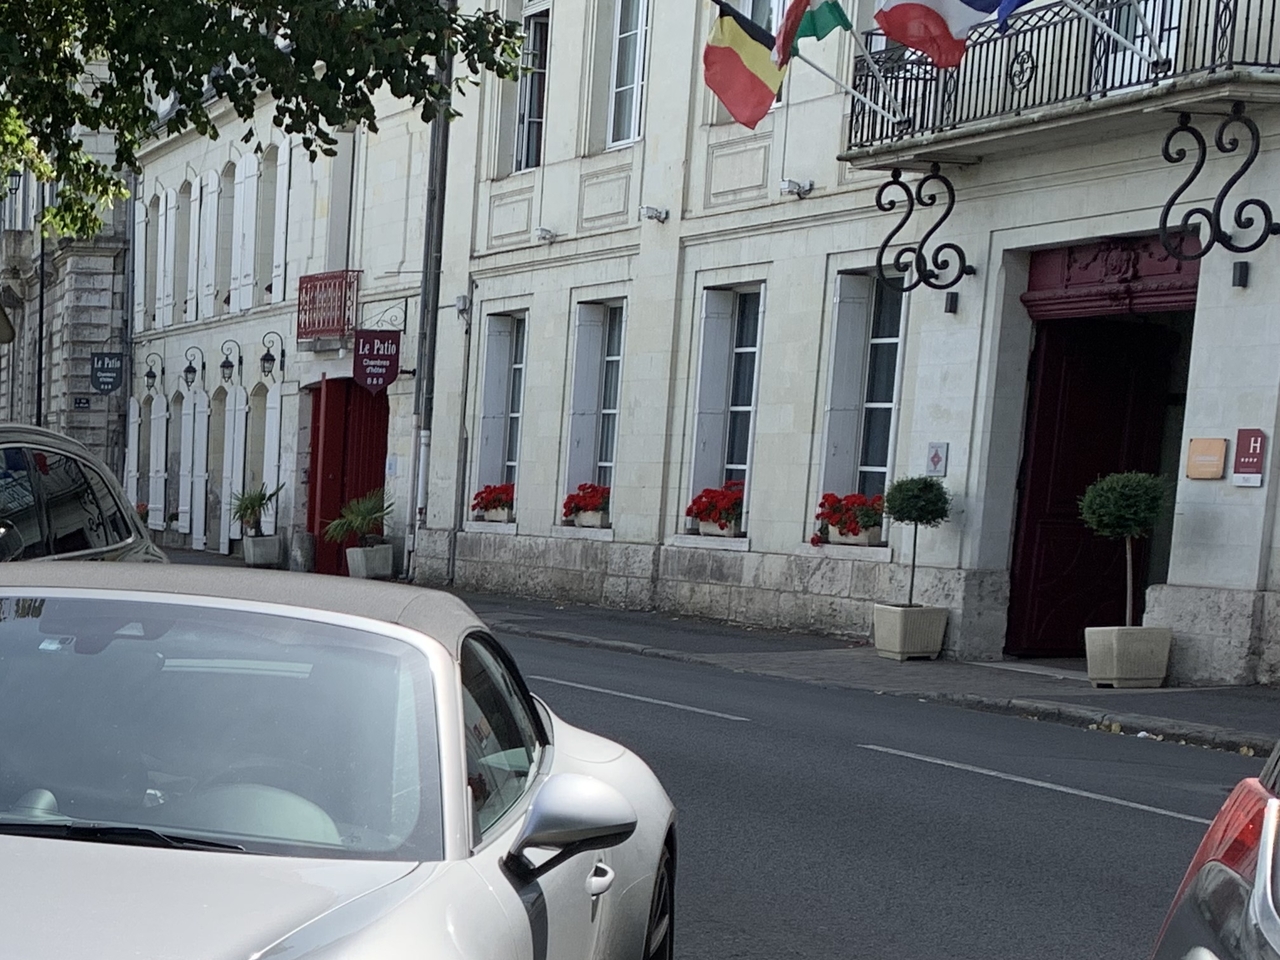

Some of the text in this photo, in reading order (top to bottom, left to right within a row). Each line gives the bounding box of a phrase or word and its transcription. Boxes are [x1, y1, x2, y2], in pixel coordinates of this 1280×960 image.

[359, 338, 397, 355] Le Patio
[94, 356, 121, 368] Le Patio
[362, 358, 390, 366] Chambres
[1249, 436, 1261, 454] H
